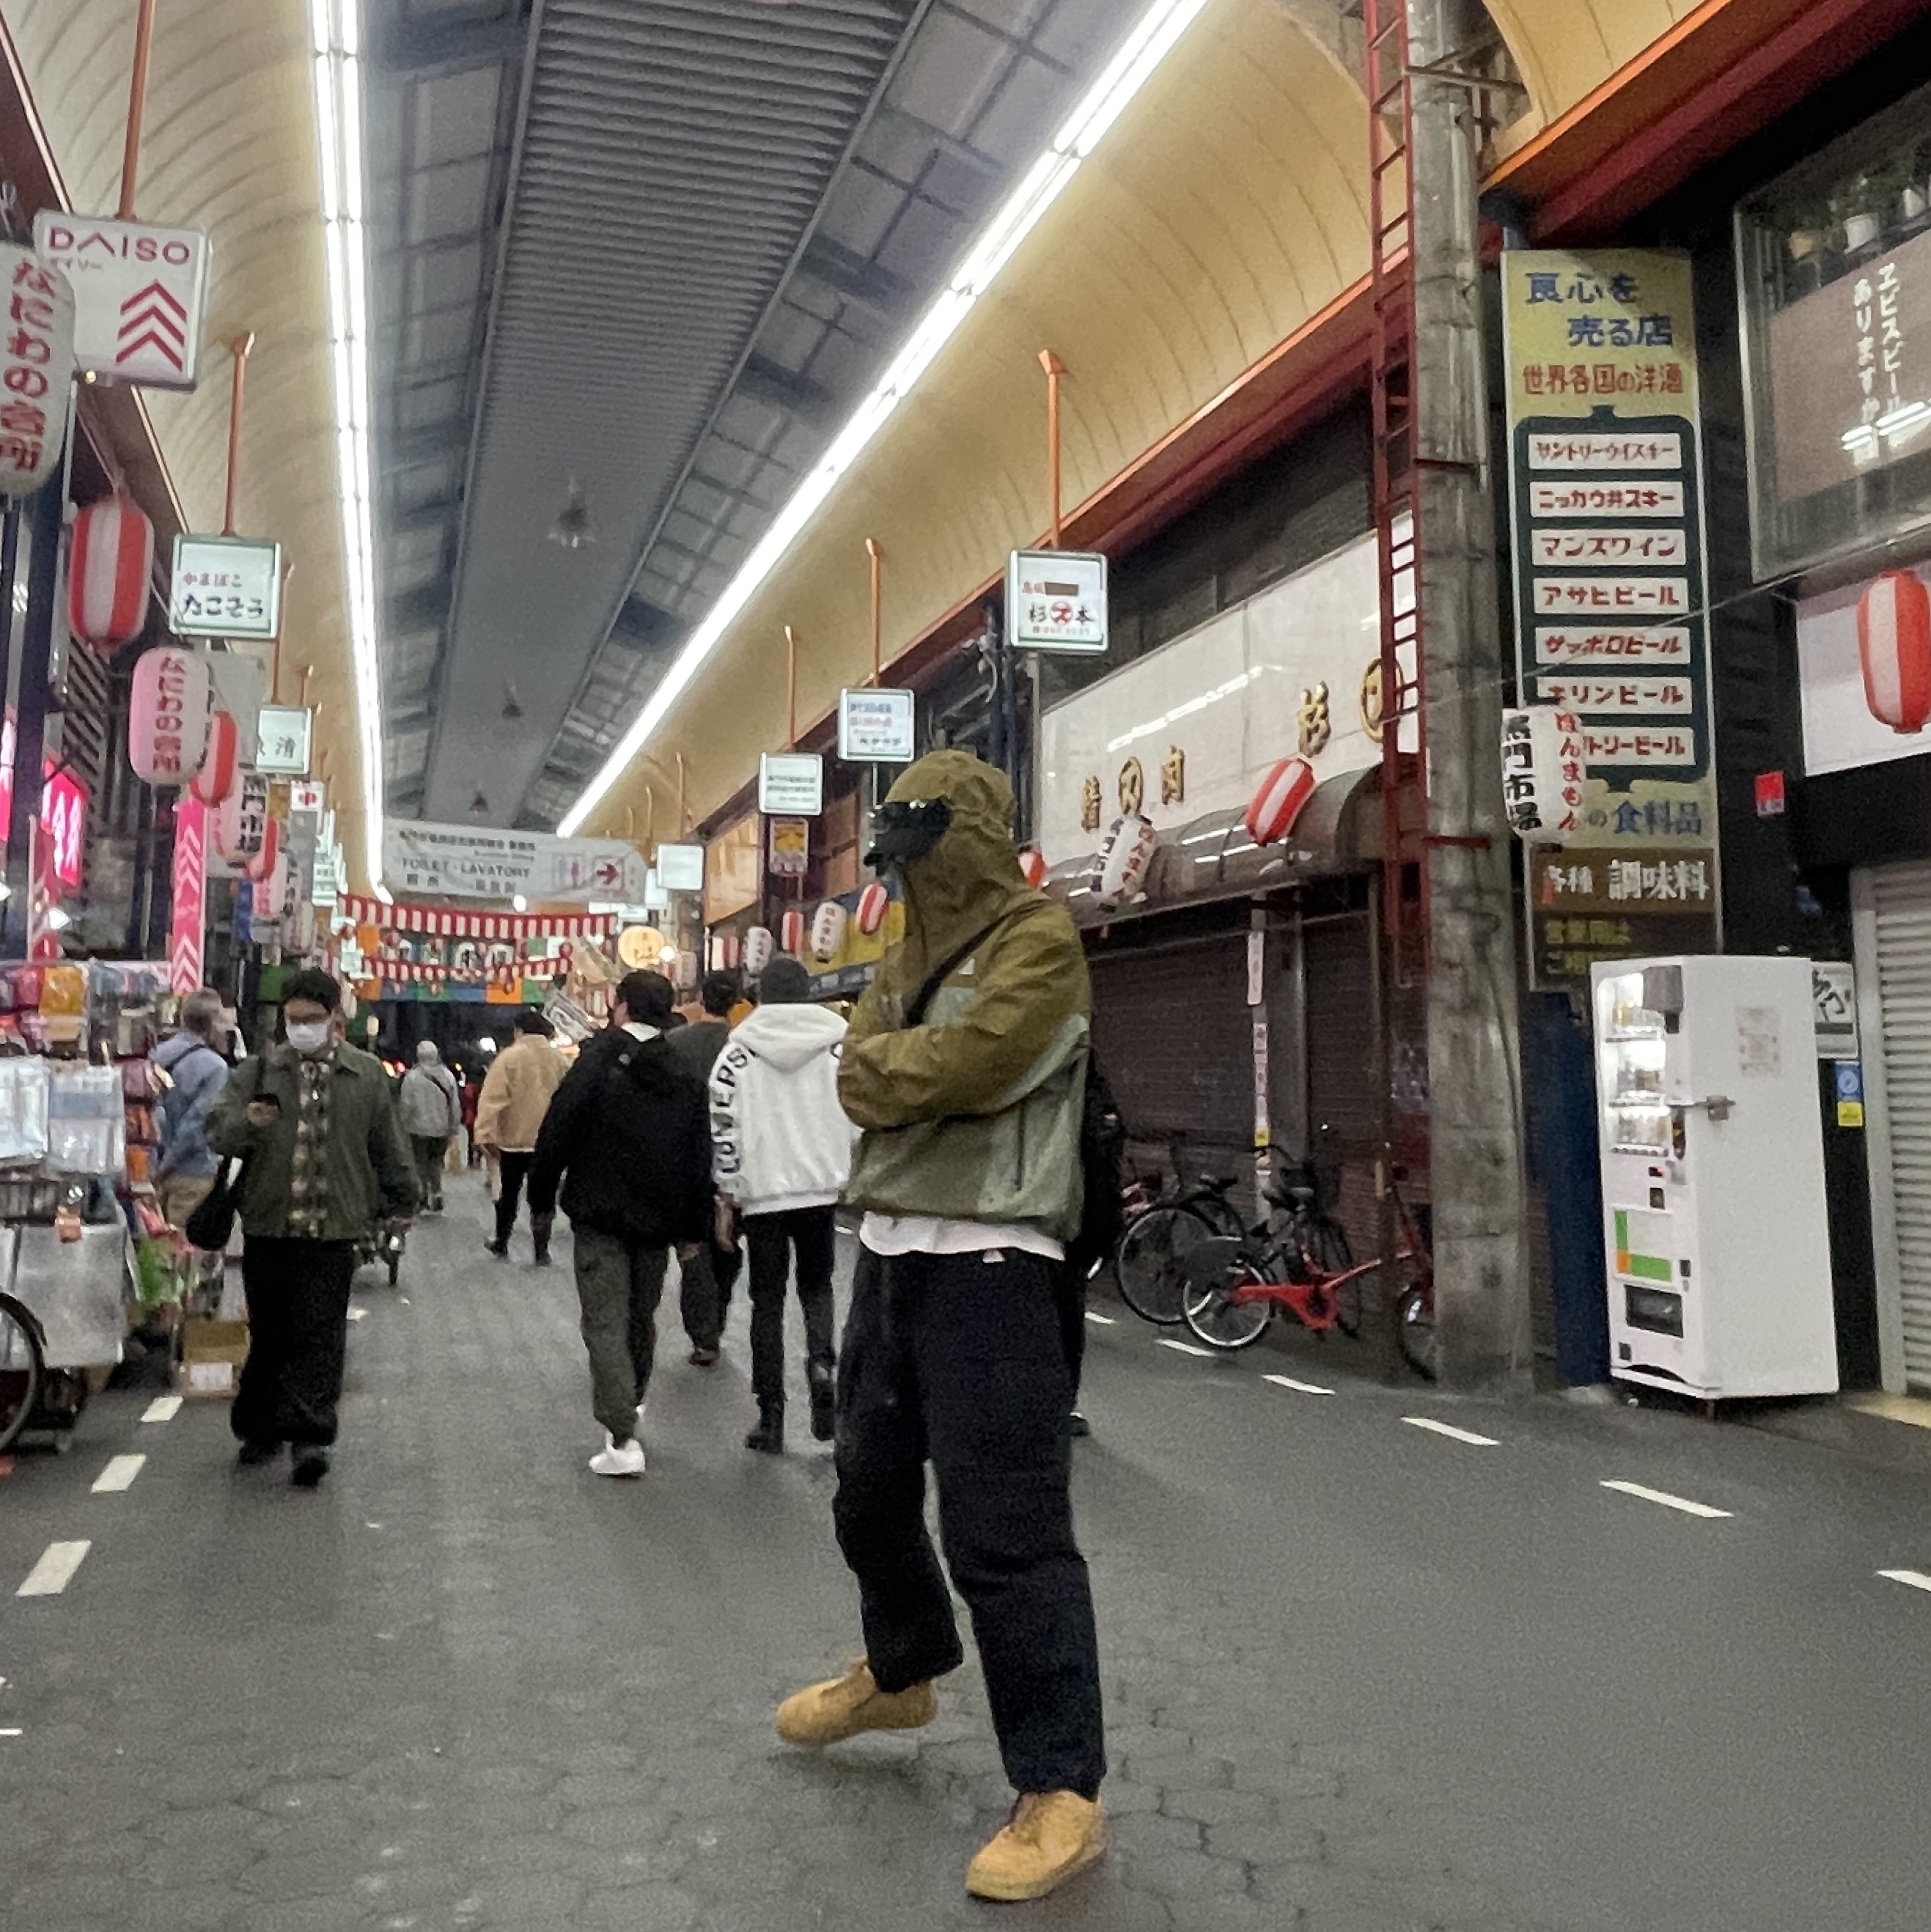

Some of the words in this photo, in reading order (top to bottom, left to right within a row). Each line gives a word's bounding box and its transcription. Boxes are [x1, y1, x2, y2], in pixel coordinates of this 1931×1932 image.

[49, 226, 190, 265] DAISO
[1524, 270, 1639, 303] 良心を
[1567, 313, 1674, 347] 売る店
[1523, 363, 1684, 394] 世界各国の洋酒
[1542, 586, 1680, 606] アサヒビール
[1545, 634, 1683, 655] サッポロビール
[1548, 685, 1684, 706] キリンビール
[1582, 735, 1685, 756] トリービール
[1608, 858, 1710, 901] 調味料
